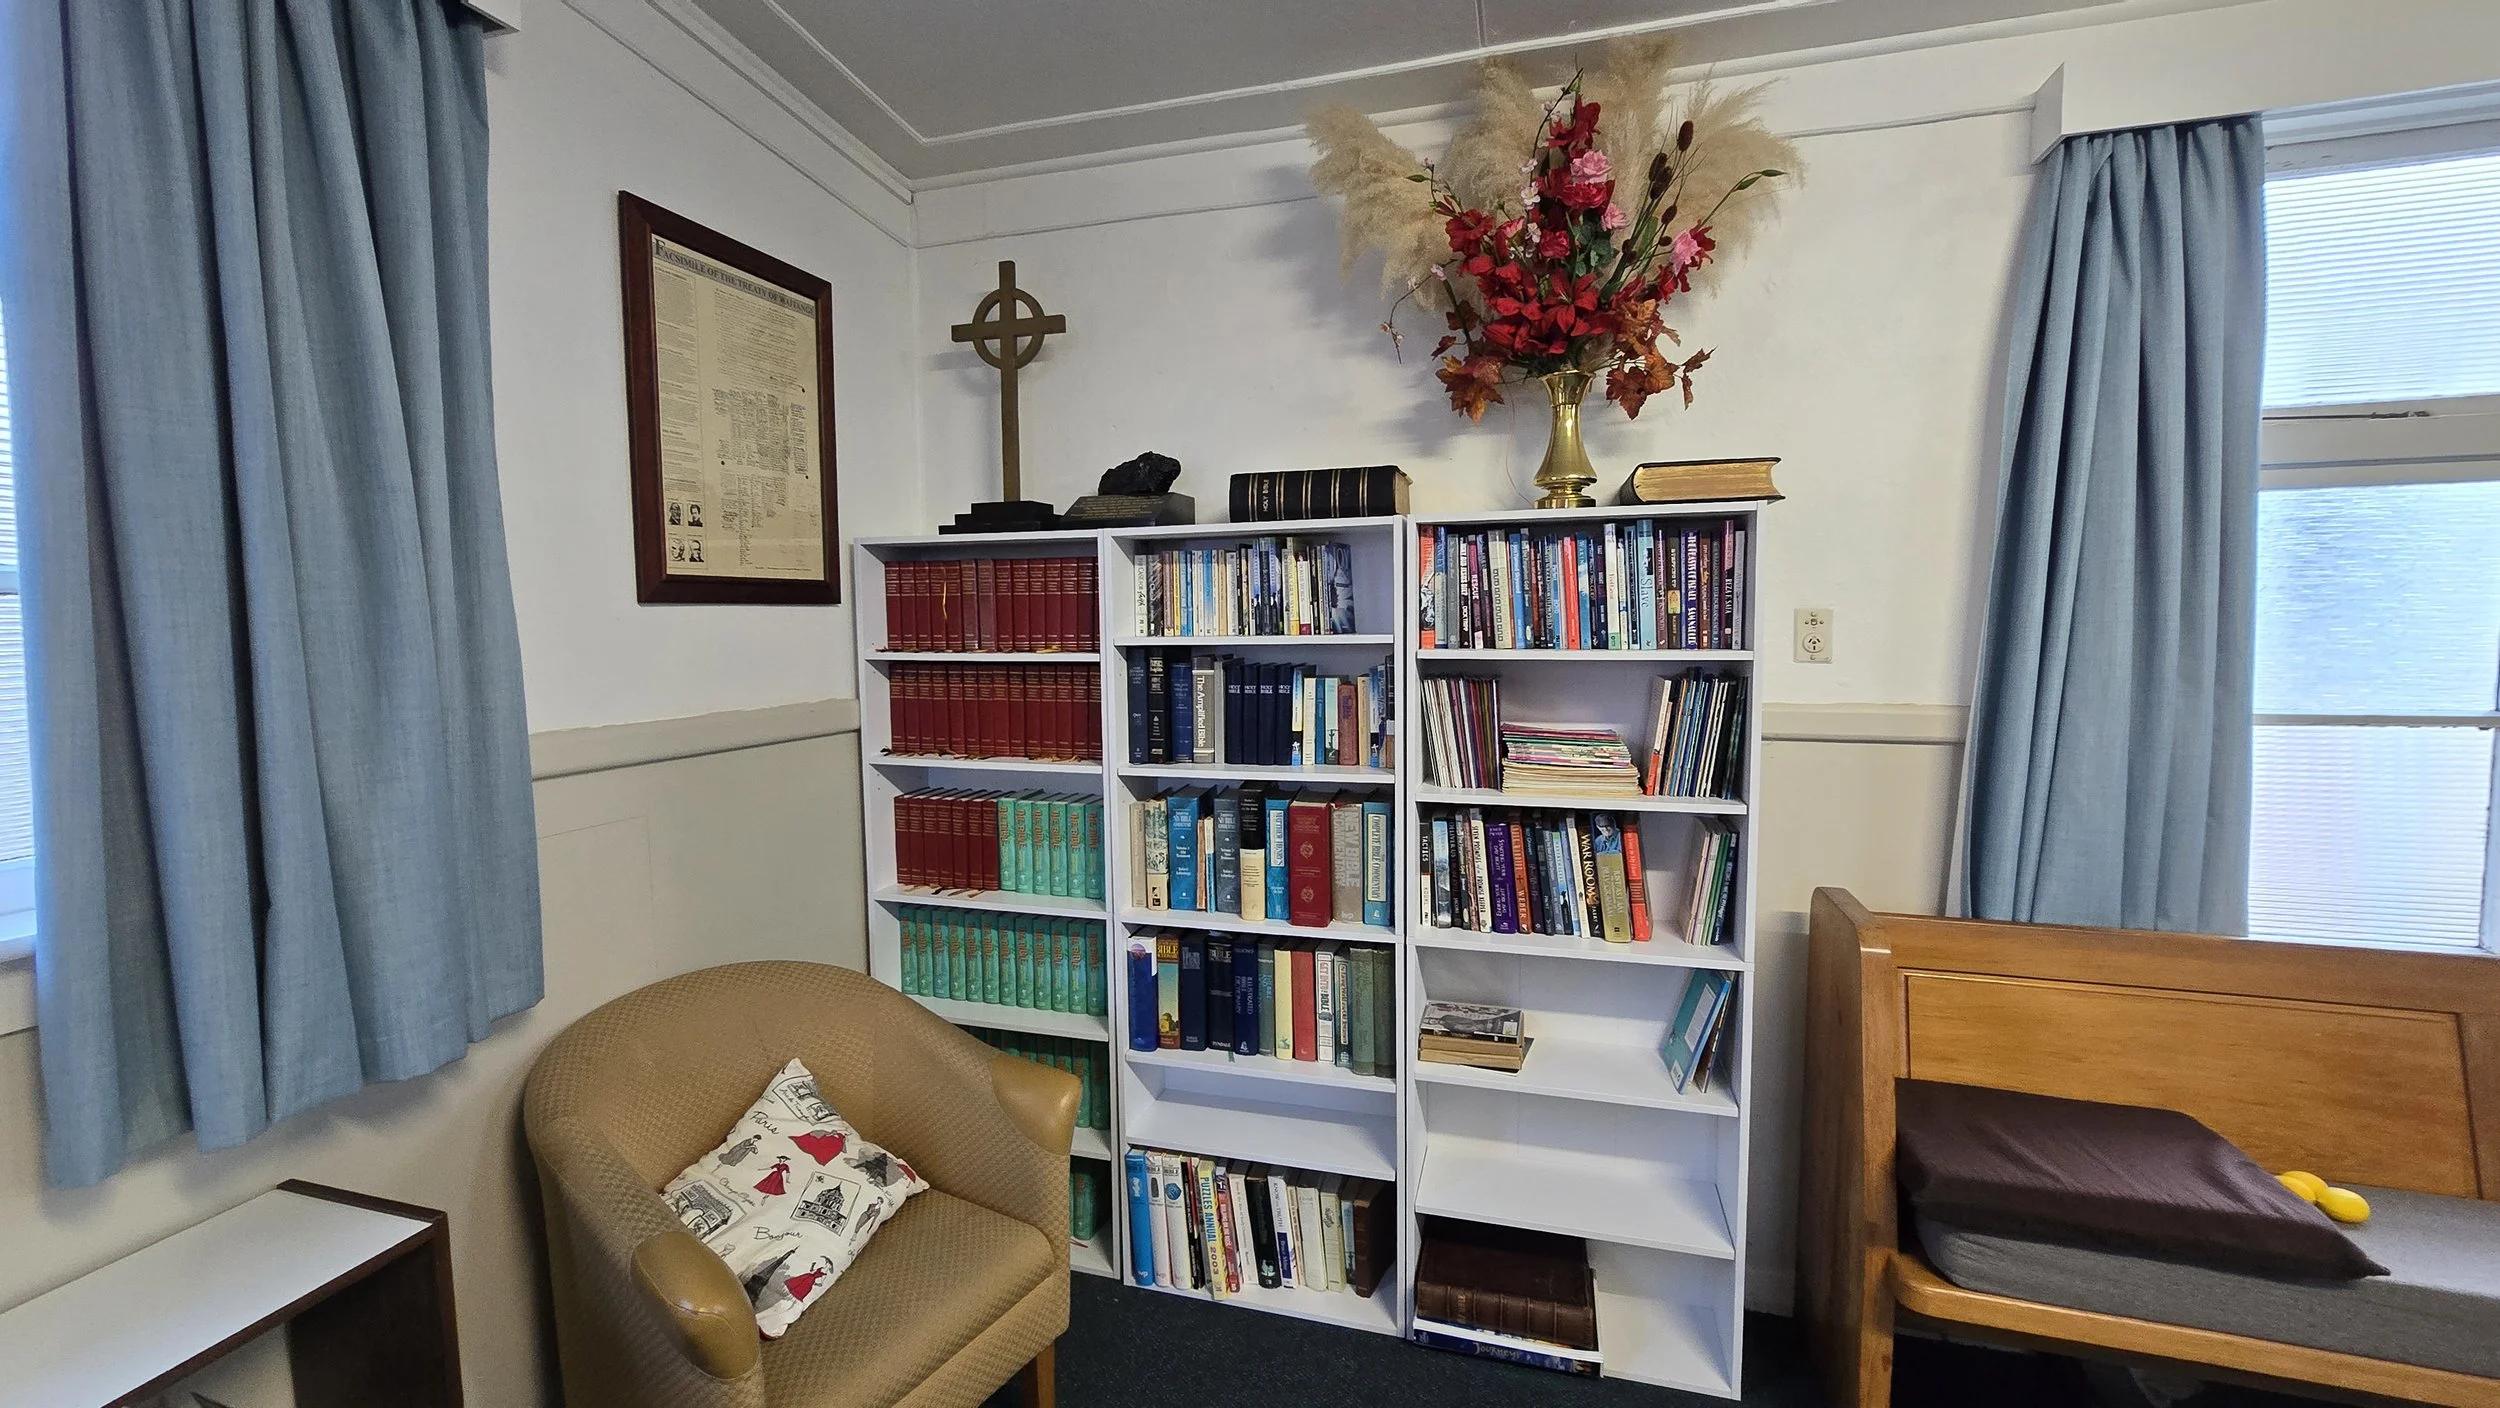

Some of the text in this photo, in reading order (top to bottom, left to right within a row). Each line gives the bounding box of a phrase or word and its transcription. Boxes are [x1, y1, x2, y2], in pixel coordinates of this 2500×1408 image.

[654, 238, 706, 274] FACSIMILE
[707, 267, 719, 281] OF
[719, 272, 737, 286] THE
[737, 278, 767, 297] TREATY
[767, 289, 779, 302] OF
[1137, 590, 1146, 606] faith
[1471, 574, 1479, 600] RESCUE
[1640, 578, 1653, 609] Slave
[1196, 676, 1206, 747] The Amplified Bible
[1333, 811, 1346, 887] COMMENTARY
[1344, 812, 1361, 888] NEW BIBLE
[1371, 815, 1381, 899] COMPLETE BIBLE COMMENTARY
[1580, 834, 1592, 859] WAR
[1584, 860, 1597, 896] ROOM
[1518, 890, 1527, 919] WEBER
[1157, 944, 1178, 954] BIBLE
[1321, 993, 1330, 1011] BIBLE
[749, 1110, 780, 1135] Paris
[753, 1226, 804, 1242] Bonjour
[1200, 1176, 1219, 1275] PUZZLES ANNUAL 2003
